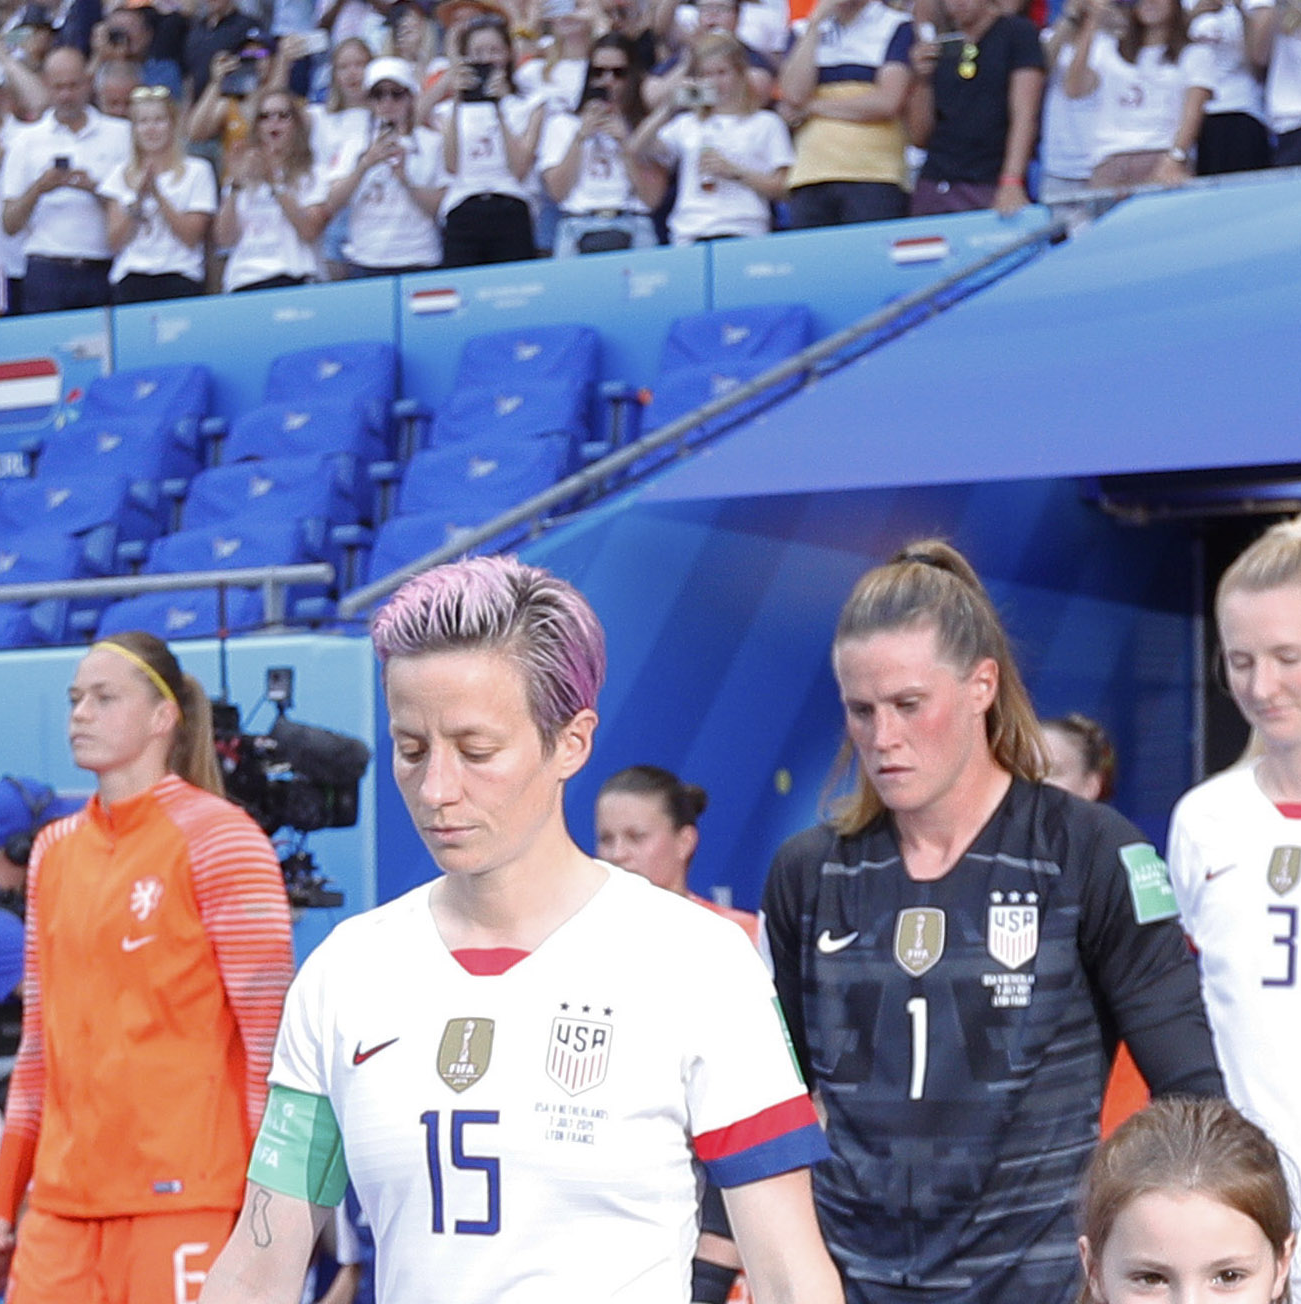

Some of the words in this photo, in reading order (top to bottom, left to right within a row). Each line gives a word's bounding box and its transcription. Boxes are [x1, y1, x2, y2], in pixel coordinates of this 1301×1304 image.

[994, 911, 1035, 933] USA
[1261, 904, 1297, 988] 3
[556, 1023, 607, 1053] USA
[906, 997, 928, 1100] 1
[448, 1063, 475, 1074] FIFA
[419, 1109, 501, 1238] 15
